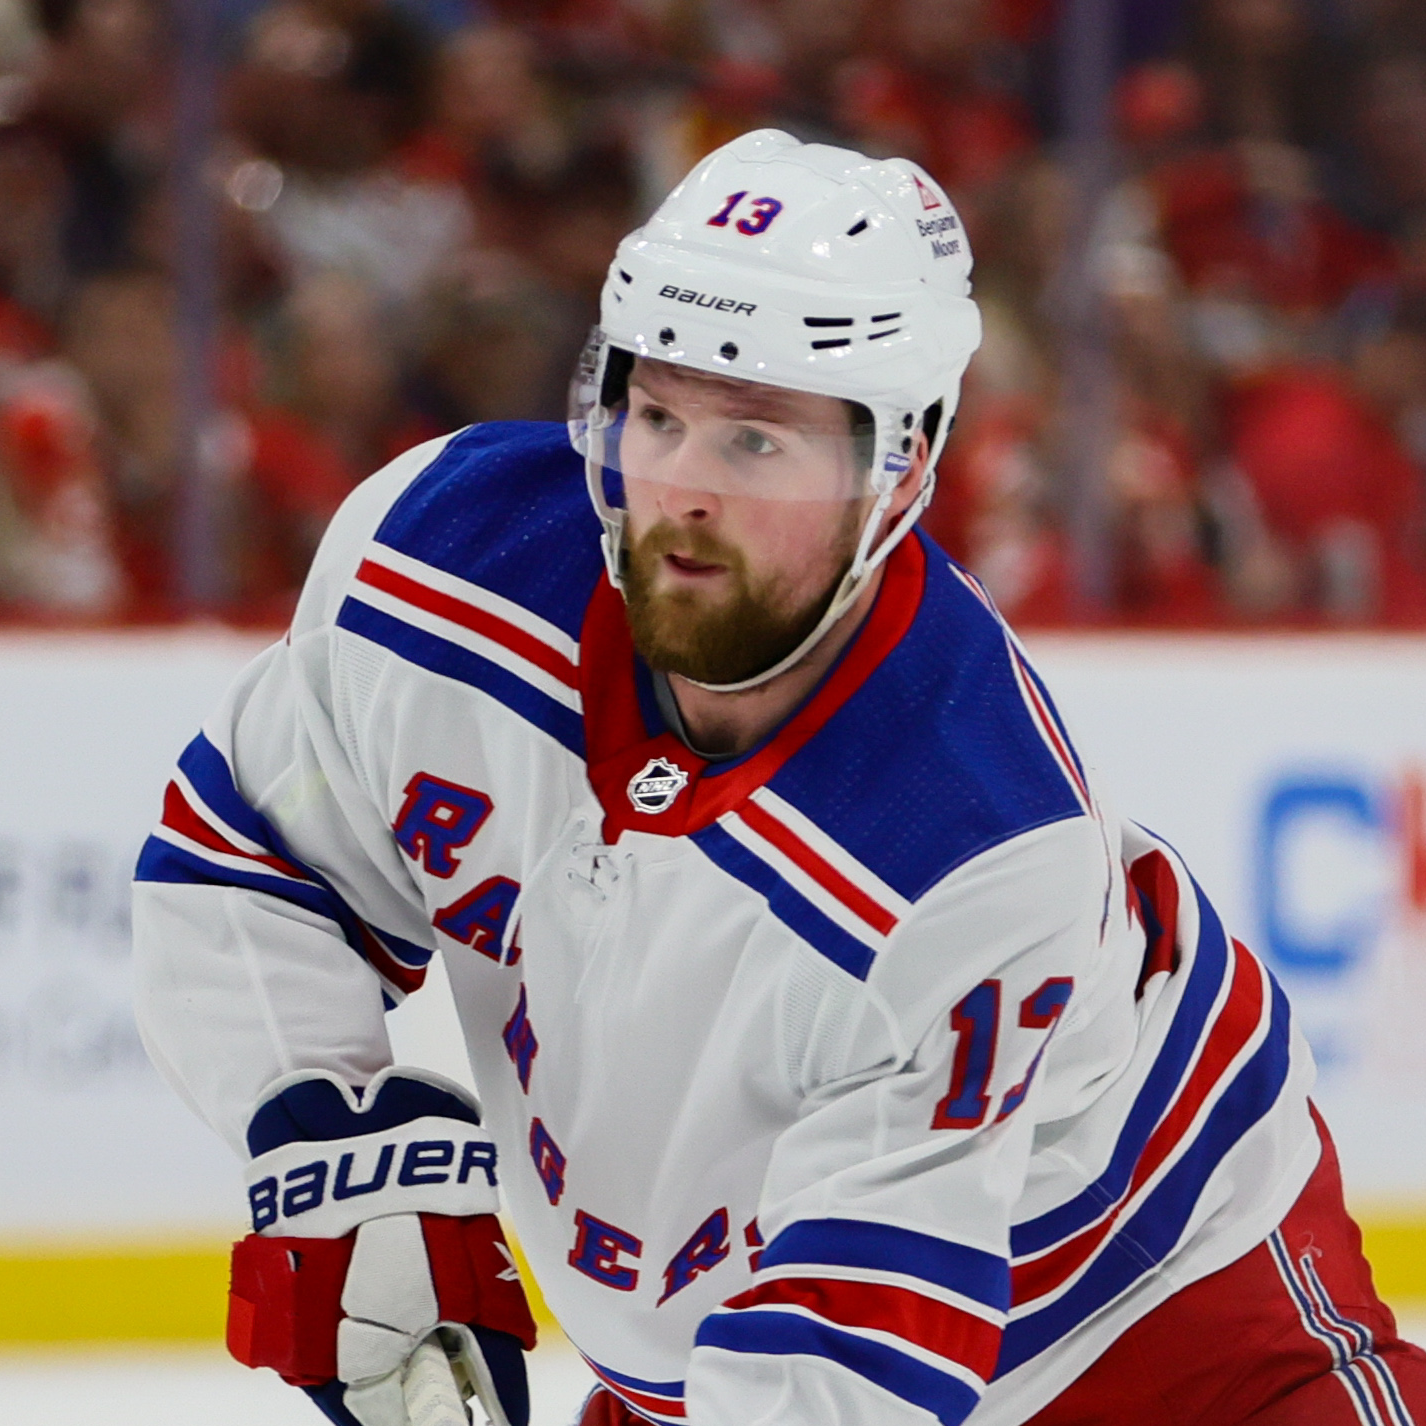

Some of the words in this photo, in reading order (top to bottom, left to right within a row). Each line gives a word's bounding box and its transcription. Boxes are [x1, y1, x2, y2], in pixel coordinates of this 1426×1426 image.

[707, 190, 783, 237] 13
[915, 211, 959, 237] Benjamin
[931, 239, 961, 259] Moore
[391, 771, 766, 1308] RANGER
